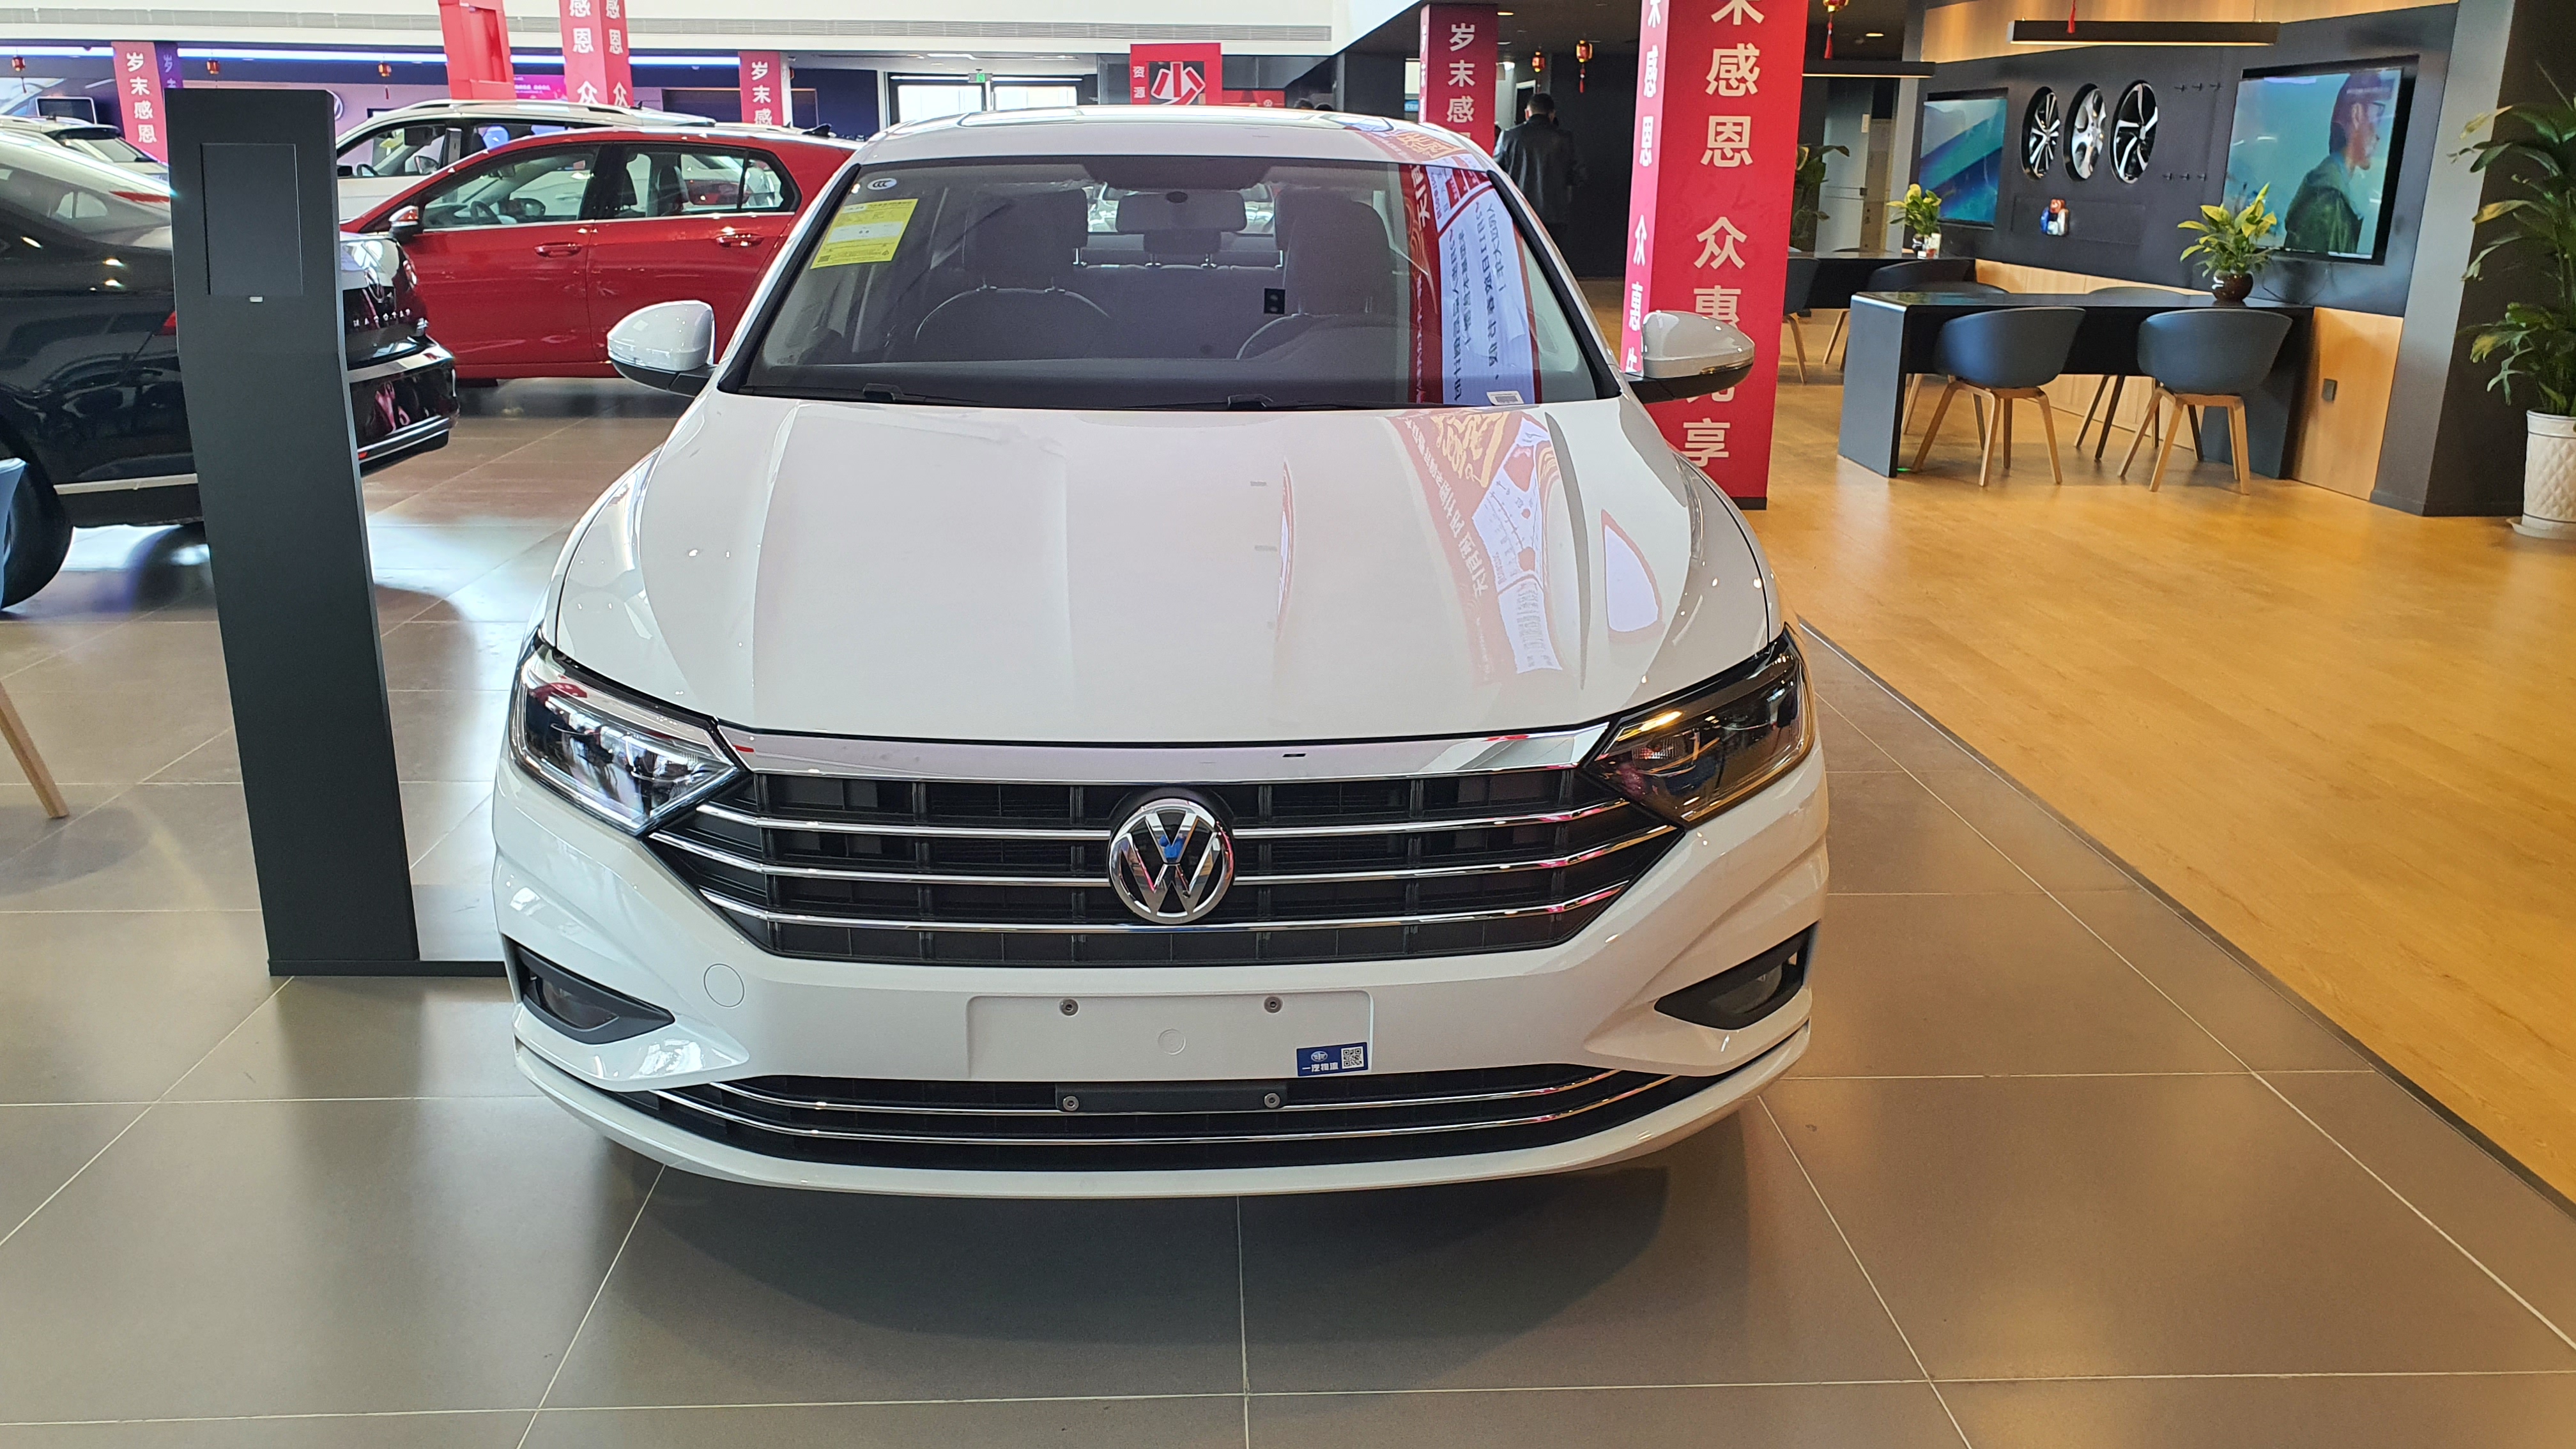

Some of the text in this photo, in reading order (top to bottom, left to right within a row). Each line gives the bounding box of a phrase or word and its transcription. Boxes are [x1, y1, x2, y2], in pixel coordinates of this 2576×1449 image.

[126, 52, 157, 143] 岁末感恩
[577, 80, 599, 103] 众
[751, 61, 772, 125] 岁末感
[1133, 66, 1146, 98] 资源
[1151, 61, 1206, 105] 少
[1446, 22, 1476, 139] 岁末感
[1682, 216, 1748, 468] 众惠享
